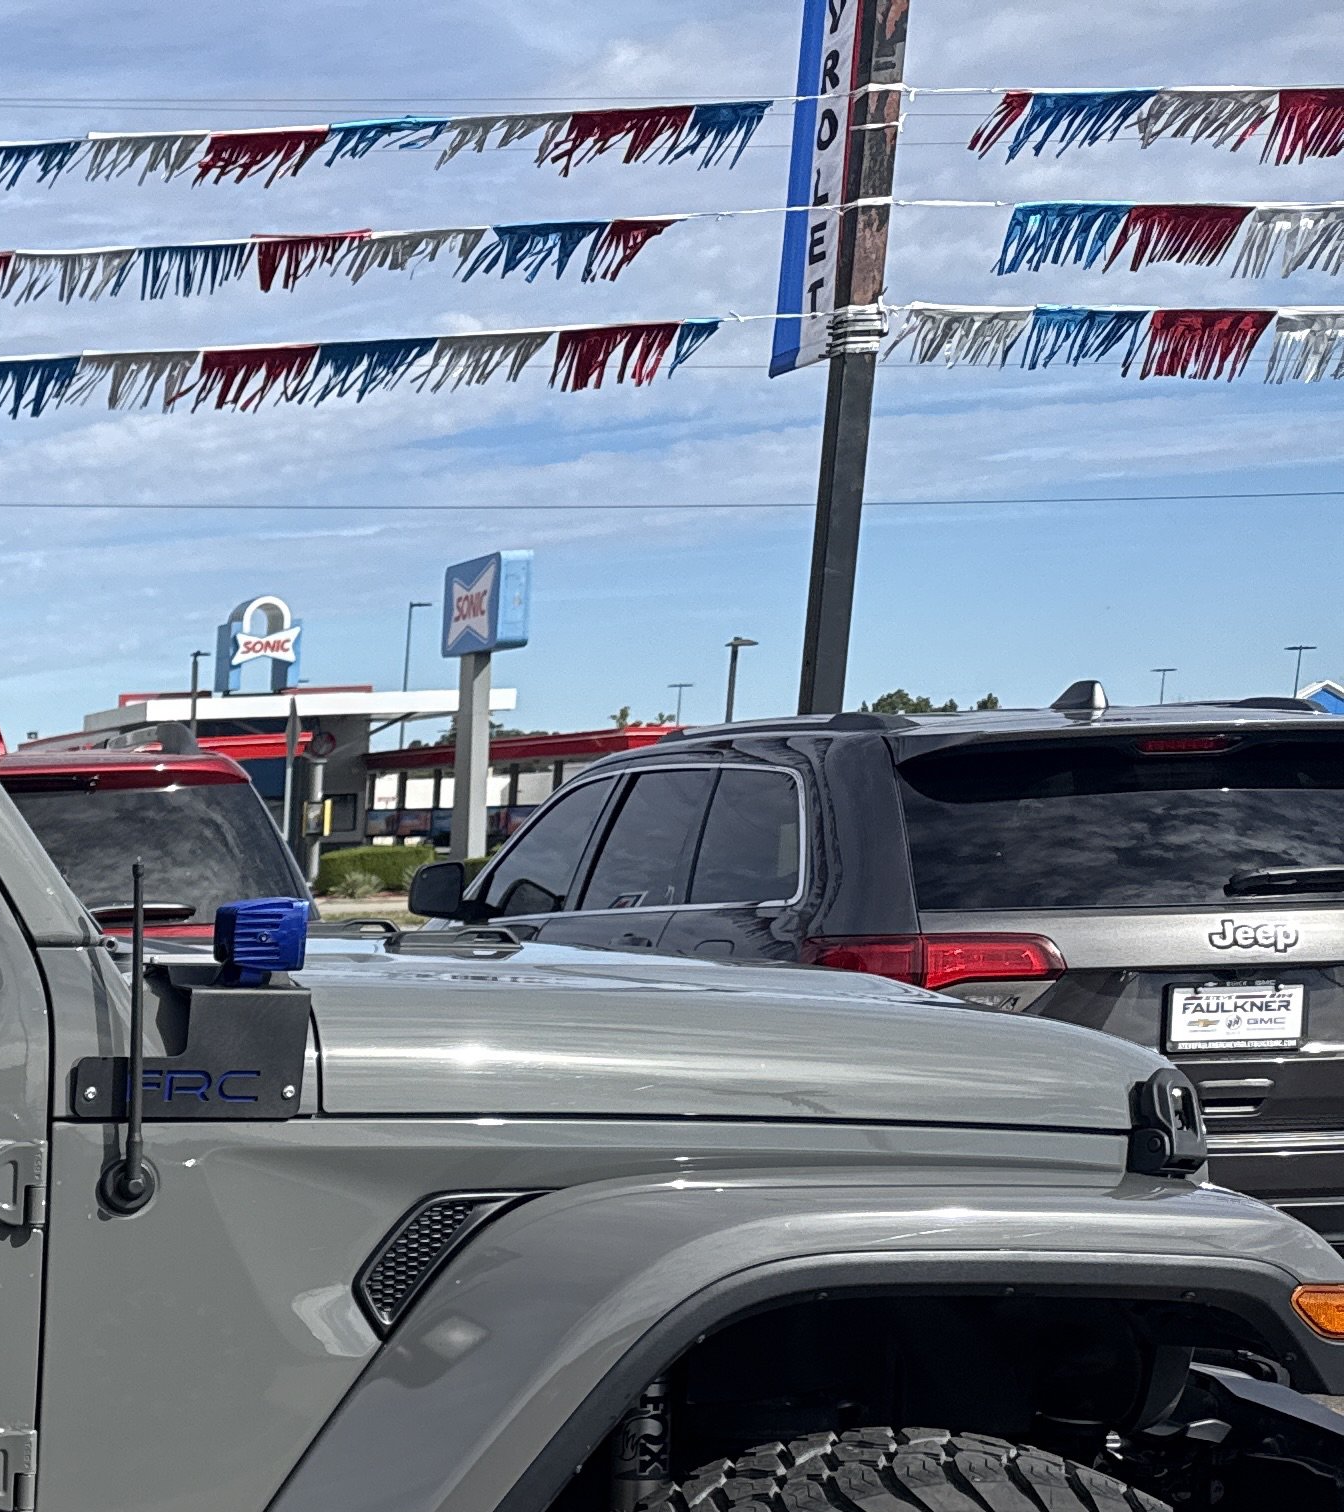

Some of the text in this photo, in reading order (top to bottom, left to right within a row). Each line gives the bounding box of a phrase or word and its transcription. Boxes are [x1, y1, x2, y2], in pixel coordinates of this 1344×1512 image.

[453, 588, 488, 622] SONIC
[240, 637, 292, 655] SONIC
[1208, 919, 1299, 953] Jeep
[1182, 1000, 1291, 1014] FAULKNER
[1246, 1016, 1286, 1026] GMC
[127, 1070, 262, 1104] FRC
